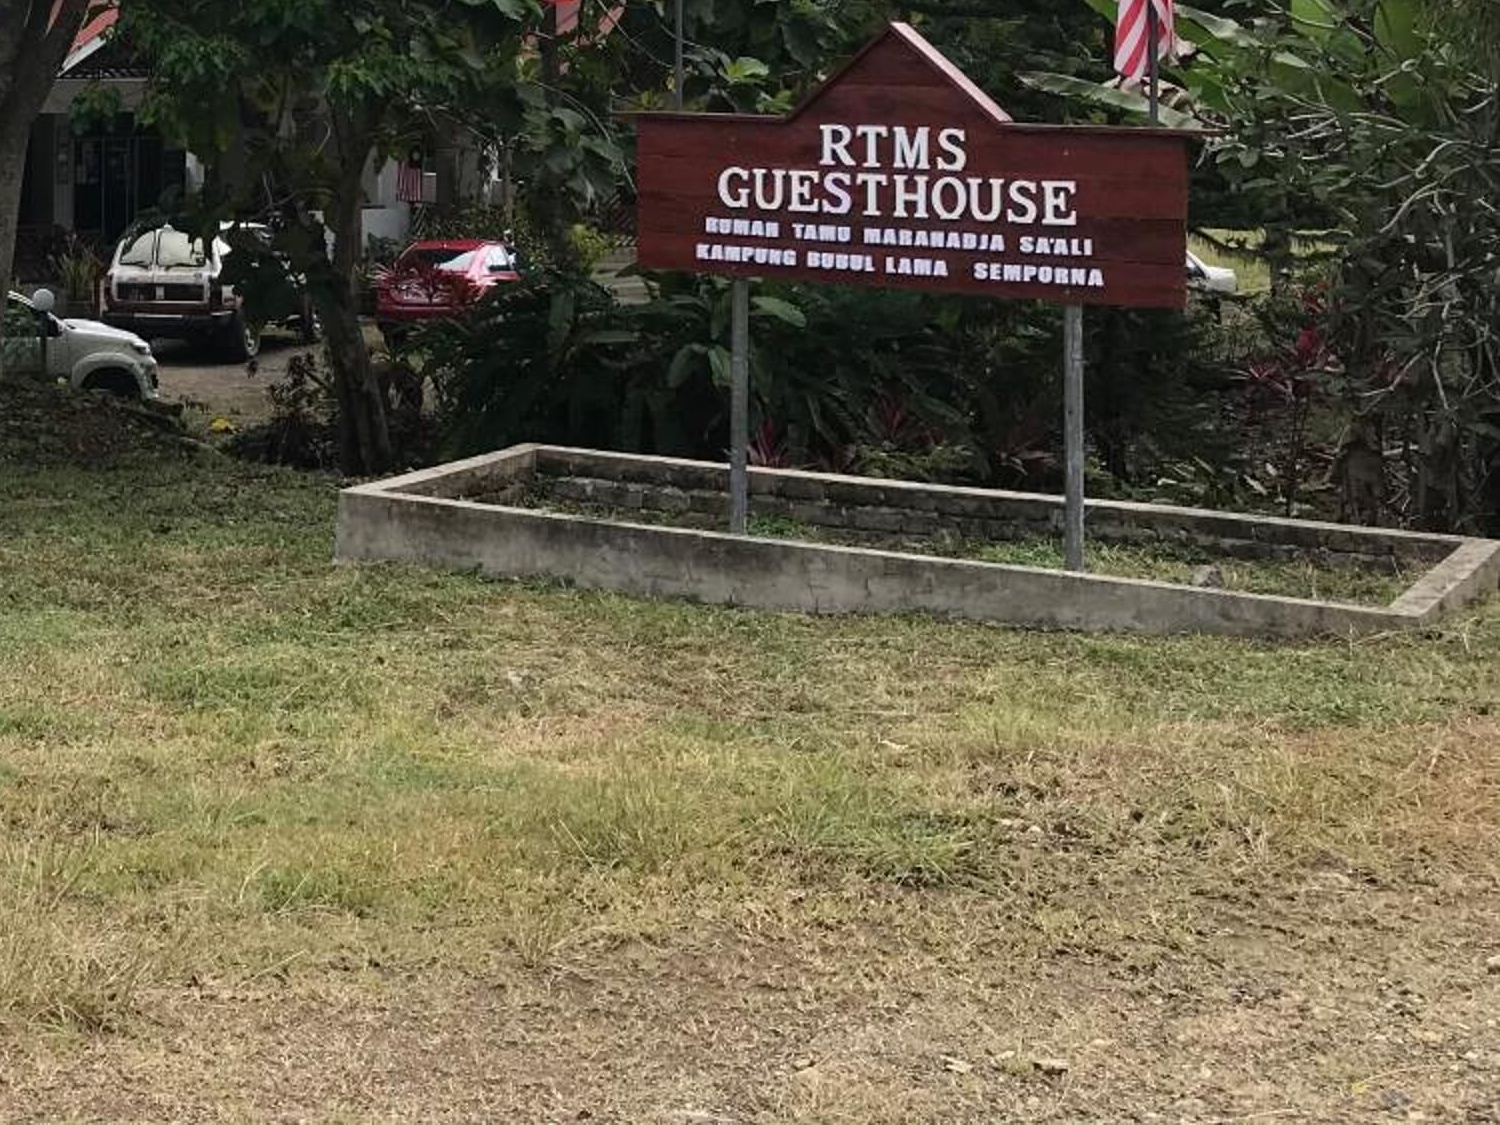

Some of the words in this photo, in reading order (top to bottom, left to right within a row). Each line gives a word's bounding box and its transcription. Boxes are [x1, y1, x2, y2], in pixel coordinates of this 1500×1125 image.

[819, 124, 967, 171] RTMS
[717, 167, 1077, 227] GUESTHOUSE
[792, 223, 851, 242] TAMU
[696, 243, 797, 266] KAMPUNG
[885, 256, 948, 276] LAMA
[973, 262, 1104, 287] SEMPORNA
